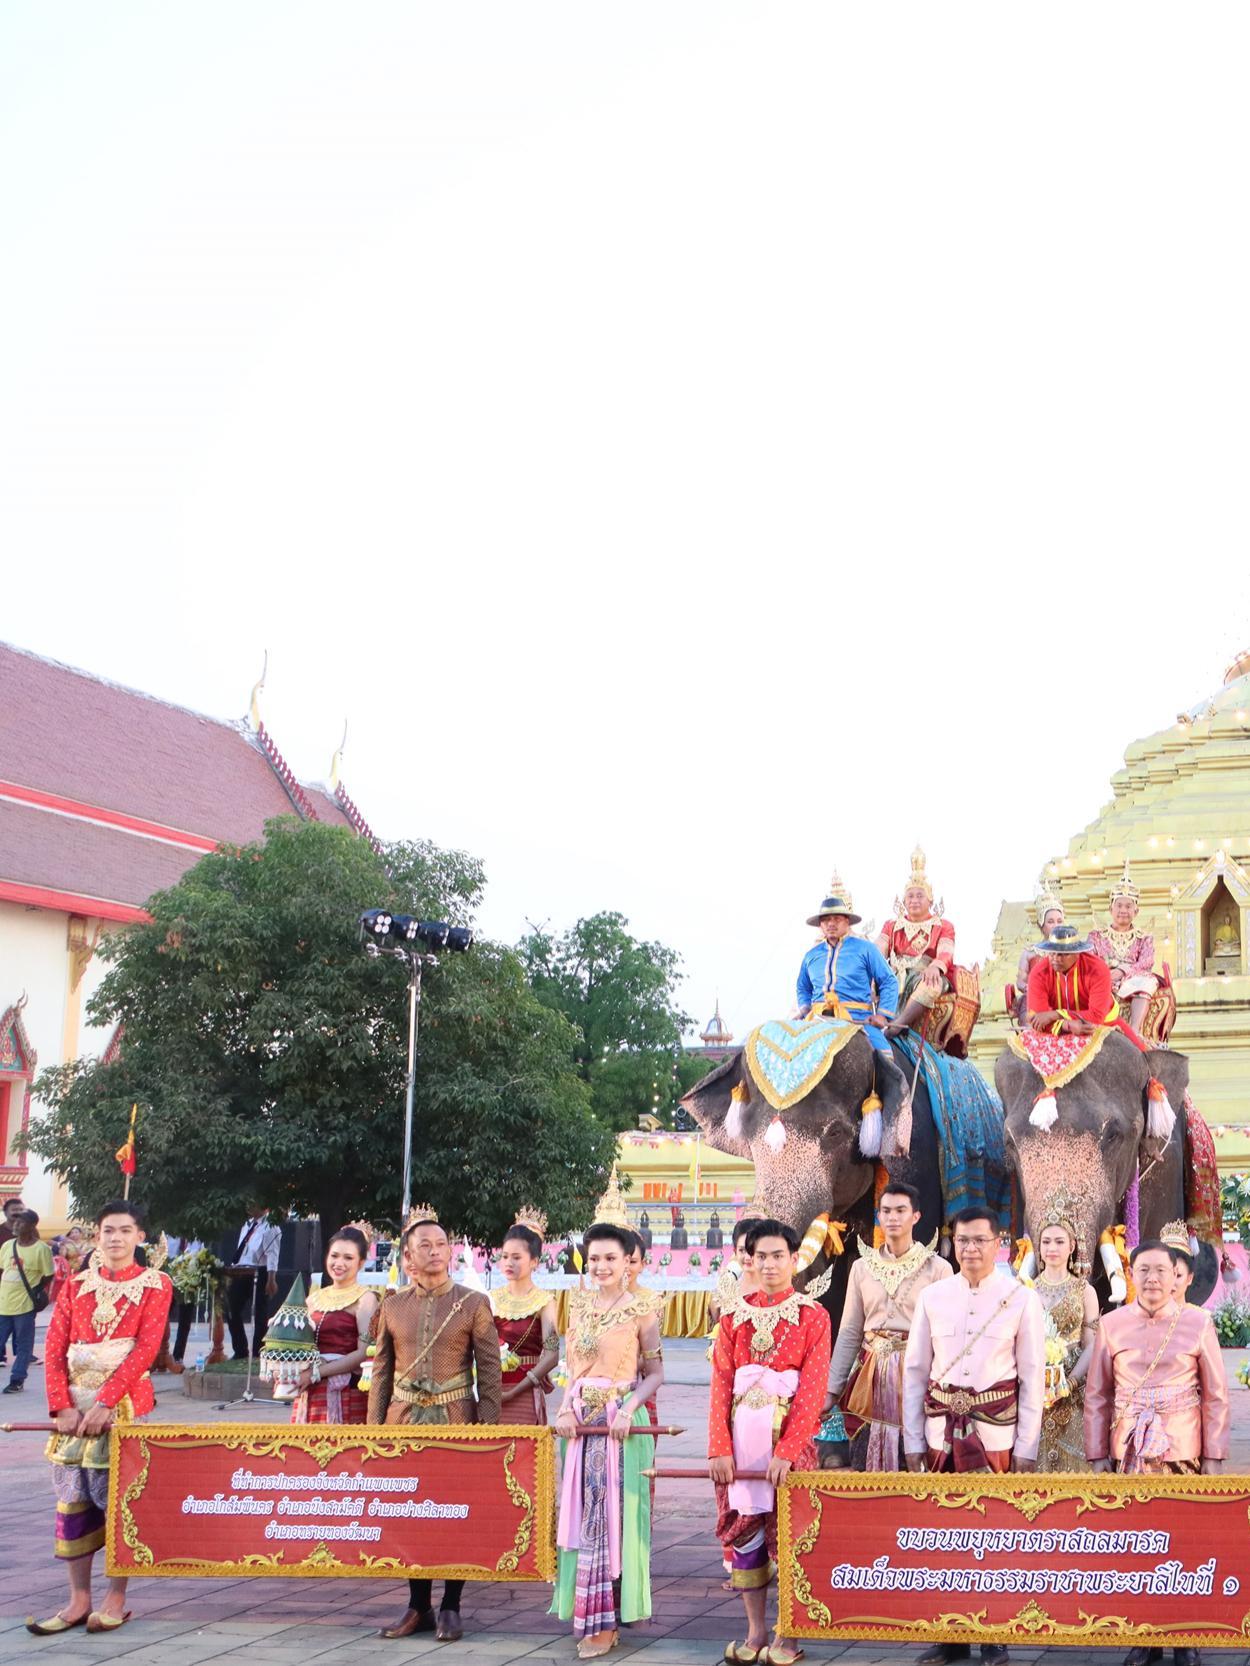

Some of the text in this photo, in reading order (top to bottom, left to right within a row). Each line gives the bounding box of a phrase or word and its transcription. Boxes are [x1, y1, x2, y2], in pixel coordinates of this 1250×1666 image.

[231, 1468, 418, 1491] ที่ทำการปกครองจังหวัดกำแพงเพชร
[182, 1494, 274, 1514] อำเภอโกสัมพีนคร
[368, 1498, 469, 1518] อำเภอปางศิลาทอง
[265, 1520, 381, 1541] อำเภอทรายทองวัฒนา
[896, 1527, 1170, 1560] ขบวนพยุหยาตราสถลมารค
[1223, 1576, 1239, 1595] ๑
